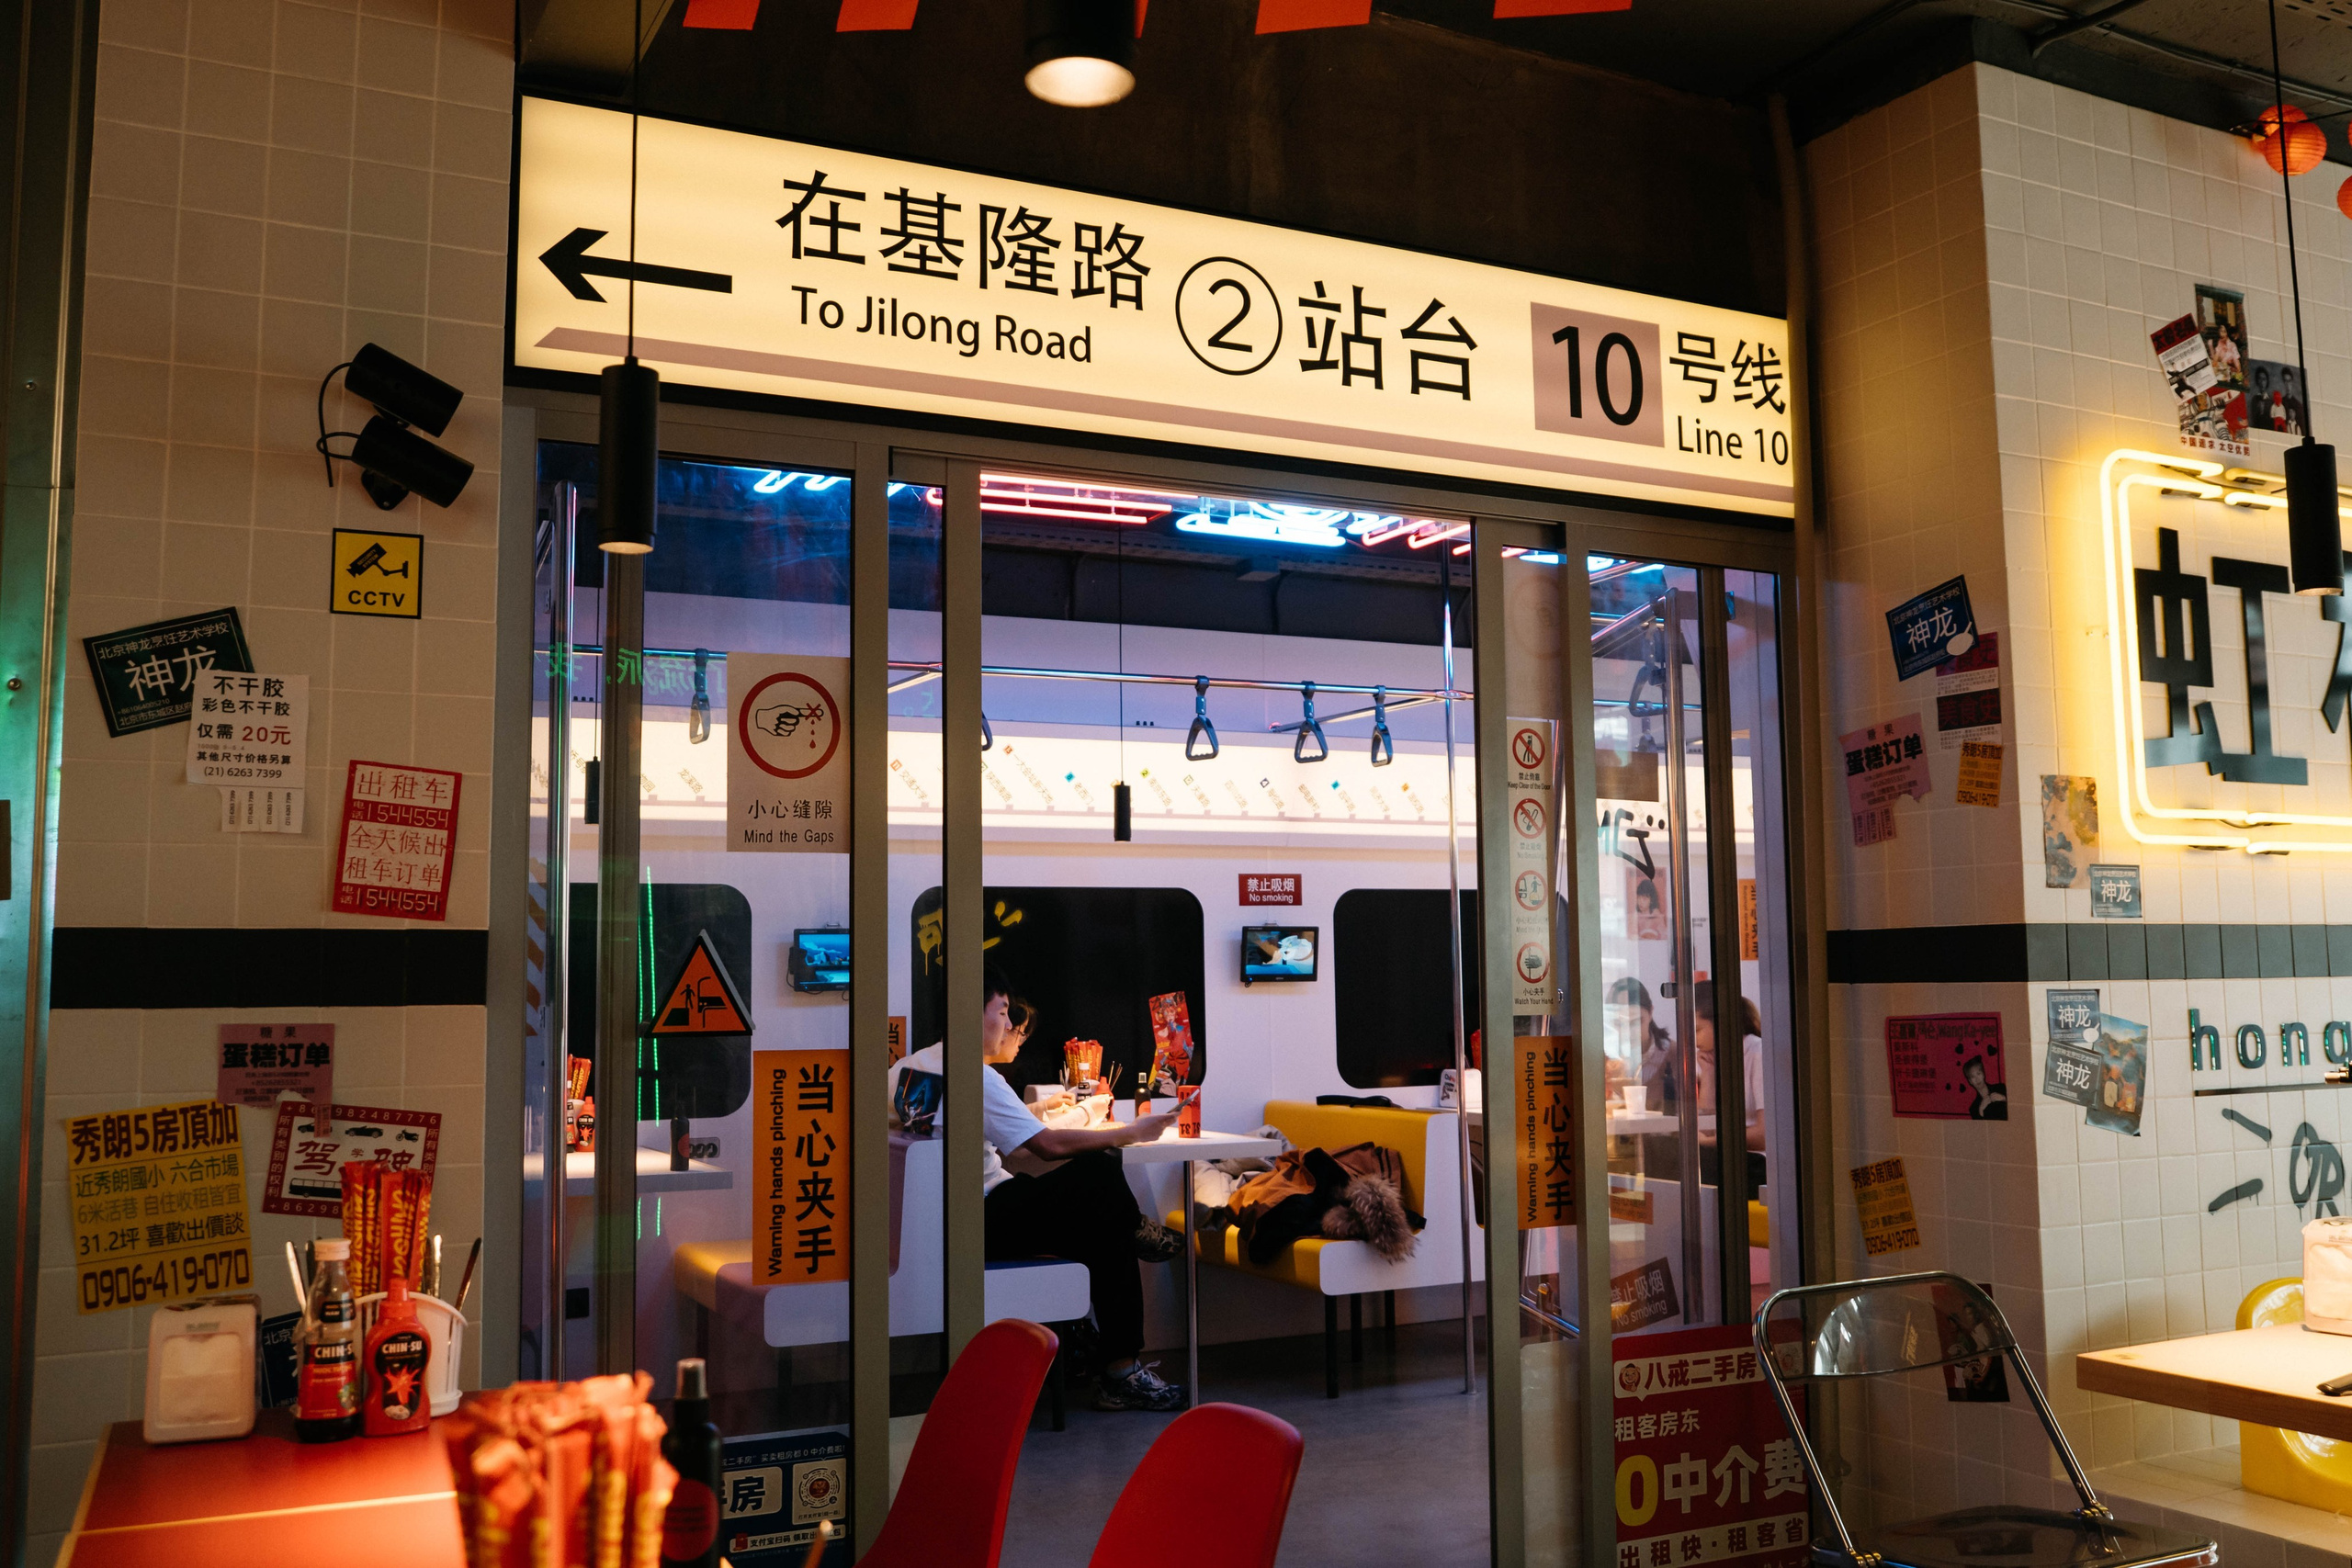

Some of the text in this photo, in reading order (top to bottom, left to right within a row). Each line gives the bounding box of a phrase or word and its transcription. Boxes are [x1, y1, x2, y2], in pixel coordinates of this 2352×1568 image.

[775, 169, 1151, 311] 在基隆路
[1298, 280, 1477, 401] 站台
[791, 286, 1092, 363] To Jilong Road
[1552, 325, 1786, 426] 10 号线
[1677, 415, 1789, 466] Line 10
[348, 591, 406, 607] CCTV
[98, 622, 230, 660] 北京神龙烹饪艺术学校
[1905, 606, 1957, 653] 神龙
[124, 645, 217, 702] 神龙
[213, 675, 285, 698] 不干胶
[202, 697, 290, 716] 彩色不干胶
[198, 723, 291, 746] 仅需 20元
[197, 751, 291, 765] 其他尺寸价格另算
[1846, 733, 1923, 776] 蛋糕订单
[204, 766, 282, 779] (21) 6263 7399
[356, 771, 448, 804] 出租车
[747, 798, 833, 820] 小心缝隙
[349, 825, 447, 857] 全天候出
[744, 829, 834, 847] Mind the Gaps
[345, 856, 441, 886] 租车订单
[1247, 877, 1295, 892] 禁止吸烟
[1250, 894, 1294, 904] No smoking
[2100, 879, 2132, 903] 神龙
[1530, 998, 1540, 1006] Your
[2058, 1004, 2091, 1028] 神龙
[222, 1043, 330, 1068] 蛋糕订单
[2056, 1059, 2091, 1089] 神龙
[72, 1101, 238, 1165] 秀朗5房頂加
[1525, 1051, 1539, 1222] Warning hands pinching
[1544, 1047, 1573, 1220] 当心夹手
[267, 1115, 290, 1196] 所有类别的权利
[795, 1064, 836, 1274] 当心夹手
[76, 1154, 239, 1198] 近秀朗國小 六合市場
[768, 1068, 786, 1277] Warning hands pinching
[144, 1183, 241, 1216] 自住收租皆宜
[80, 1213, 244, 1255] 31.2坪 喜歡出價談
[84, 1248, 250, 1310] 0906-419-070
[1616, 1299, 1668, 1327] No smoking
[1644, 1352, 1757, 1391] 八戒二手房
[1615, 1408, 1700, 1442] 租客房东
[750, 1534, 790, 1548] 支付宝扫码
